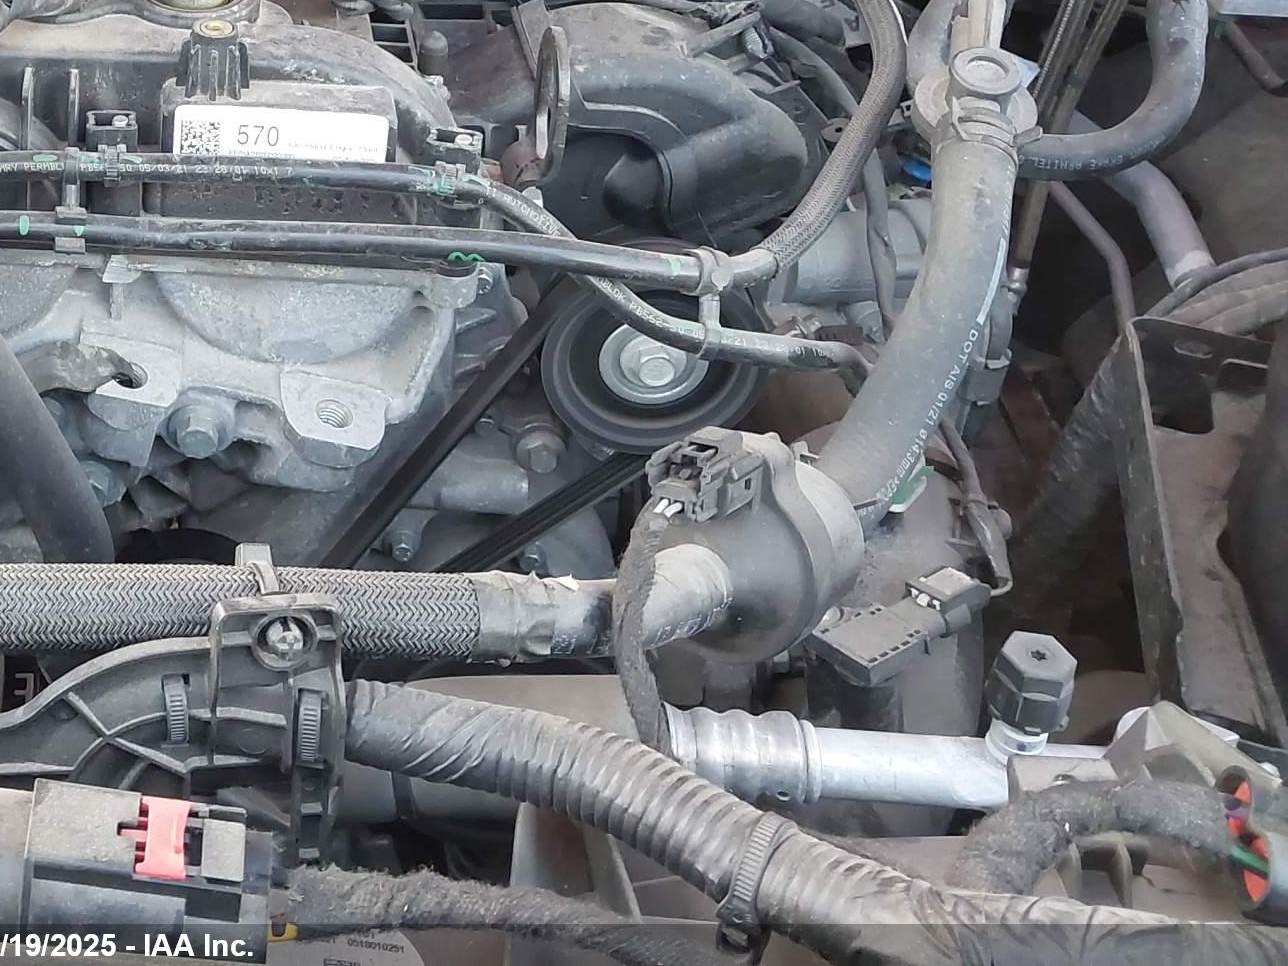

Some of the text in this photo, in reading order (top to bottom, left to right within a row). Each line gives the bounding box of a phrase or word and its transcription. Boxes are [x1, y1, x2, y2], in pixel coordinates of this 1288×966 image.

[236, 124, 280, 147] 570
[959, 329, 979, 364] DOT
[944, 364, 962, 390] AIS
[927, 391, 949, 426] 01/21
